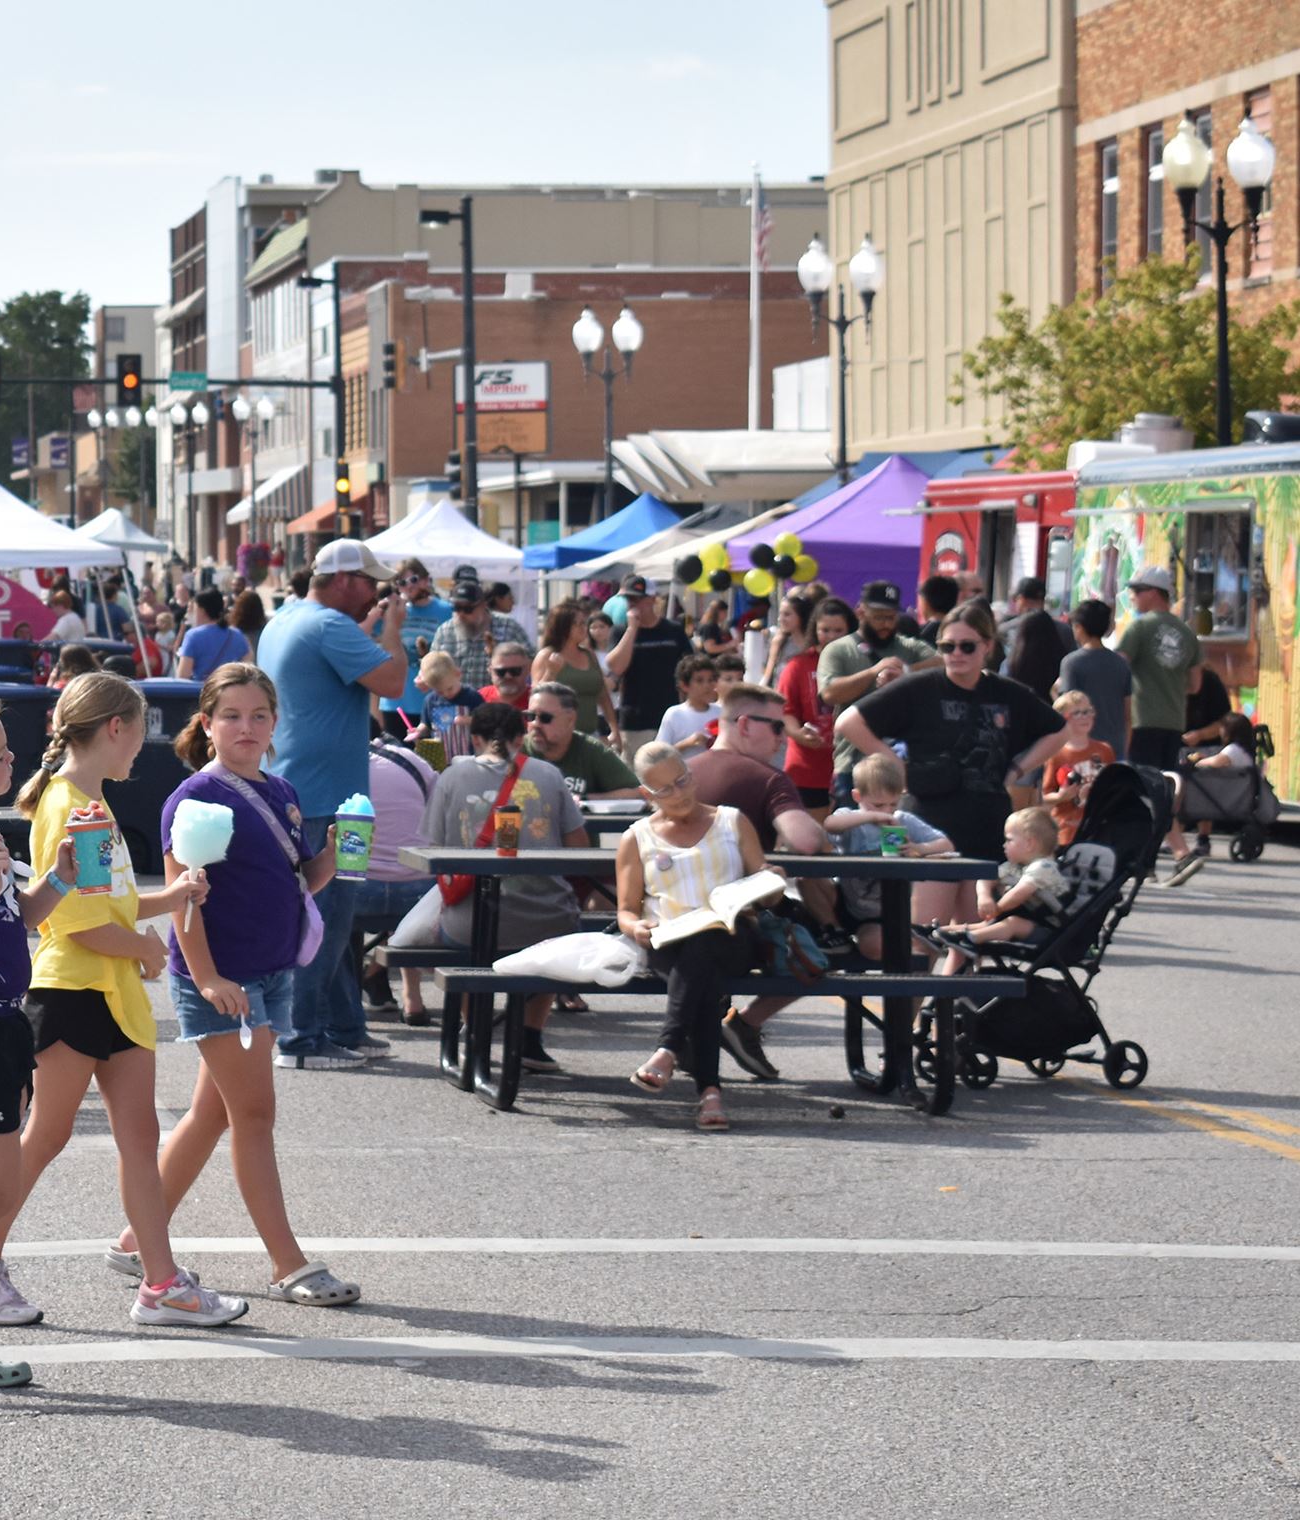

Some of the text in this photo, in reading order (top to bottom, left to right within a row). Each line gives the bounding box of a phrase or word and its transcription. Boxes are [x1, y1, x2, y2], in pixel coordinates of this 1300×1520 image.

[475, 369, 513, 385] FS
[481, 384, 528, 394] IMPRINT
[222, 772, 256, 799] NIKE
[564, 776, 586, 793] SH
